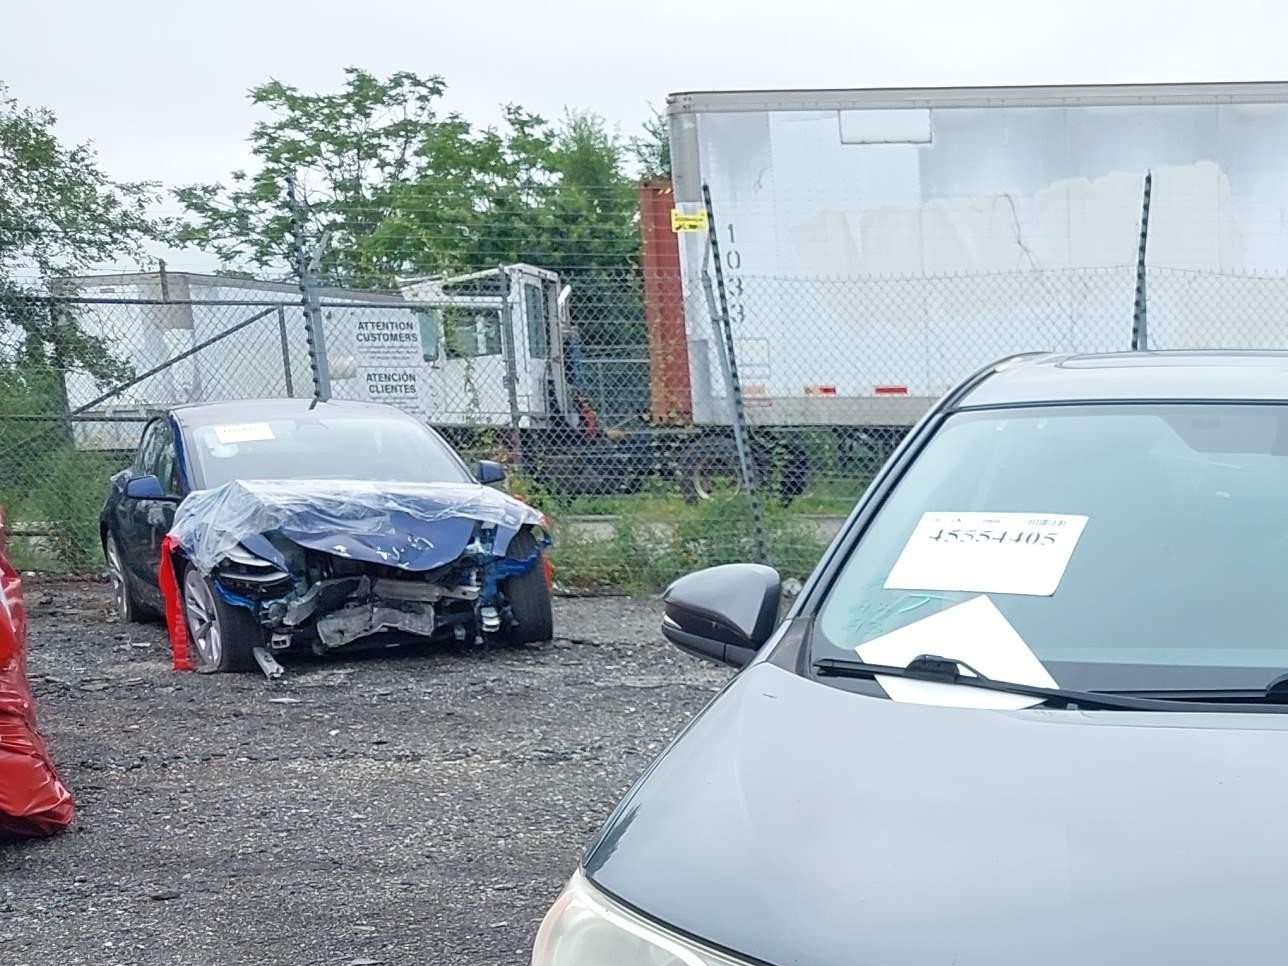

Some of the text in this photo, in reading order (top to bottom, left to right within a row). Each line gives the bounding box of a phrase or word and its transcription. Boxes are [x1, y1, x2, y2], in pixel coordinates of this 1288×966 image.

[358, 321, 414, 331] ATTENTION
[356, 333, 418, 342] CUSTOMERS
[366, 370, 416, 382] ATENCIÓN
[368, 384, 417, 394] CLIENTES
